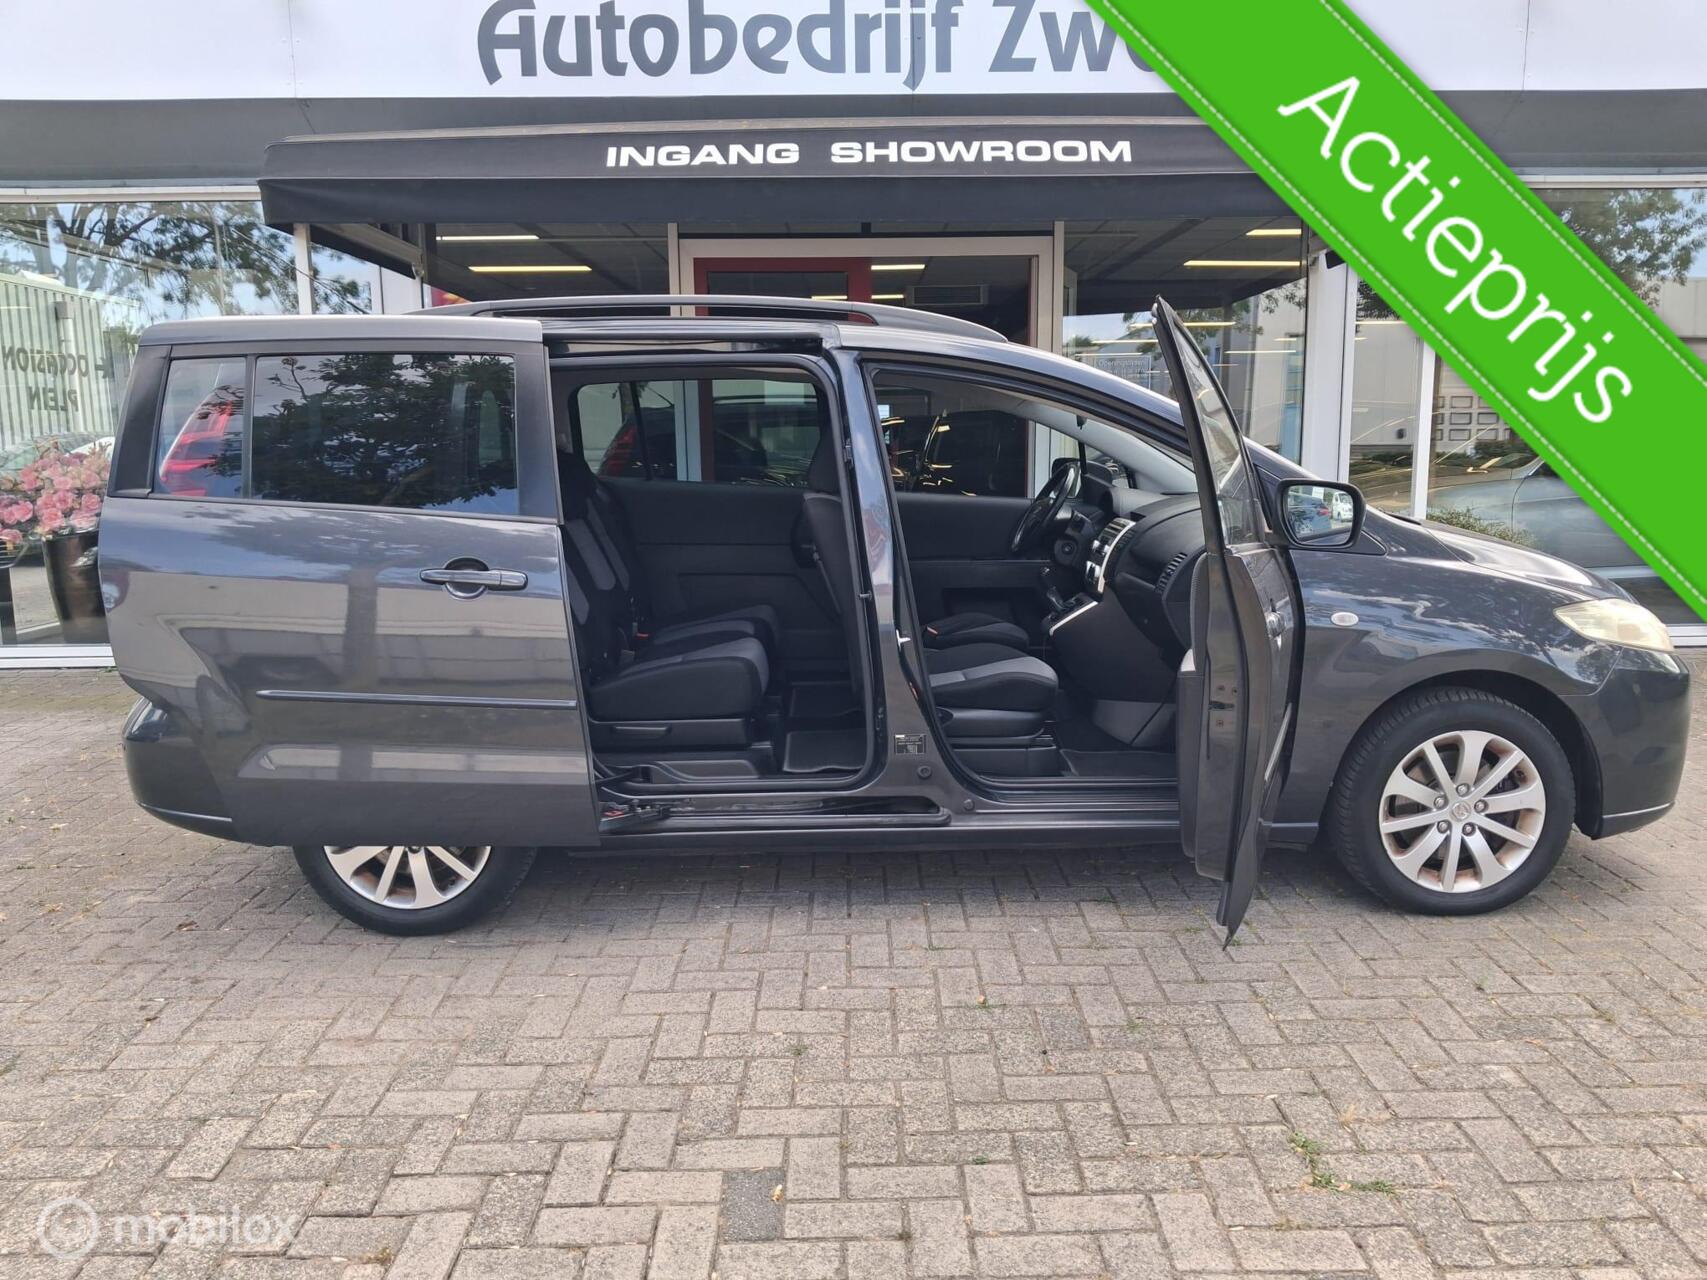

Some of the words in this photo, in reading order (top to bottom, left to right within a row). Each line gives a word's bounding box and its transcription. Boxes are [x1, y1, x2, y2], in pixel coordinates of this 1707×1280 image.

[477, 0, 964, 91] Autobedrijf
[605, 143, 800, 168] INGANG
[830, 140, 1133, 164] SHOWROOM
